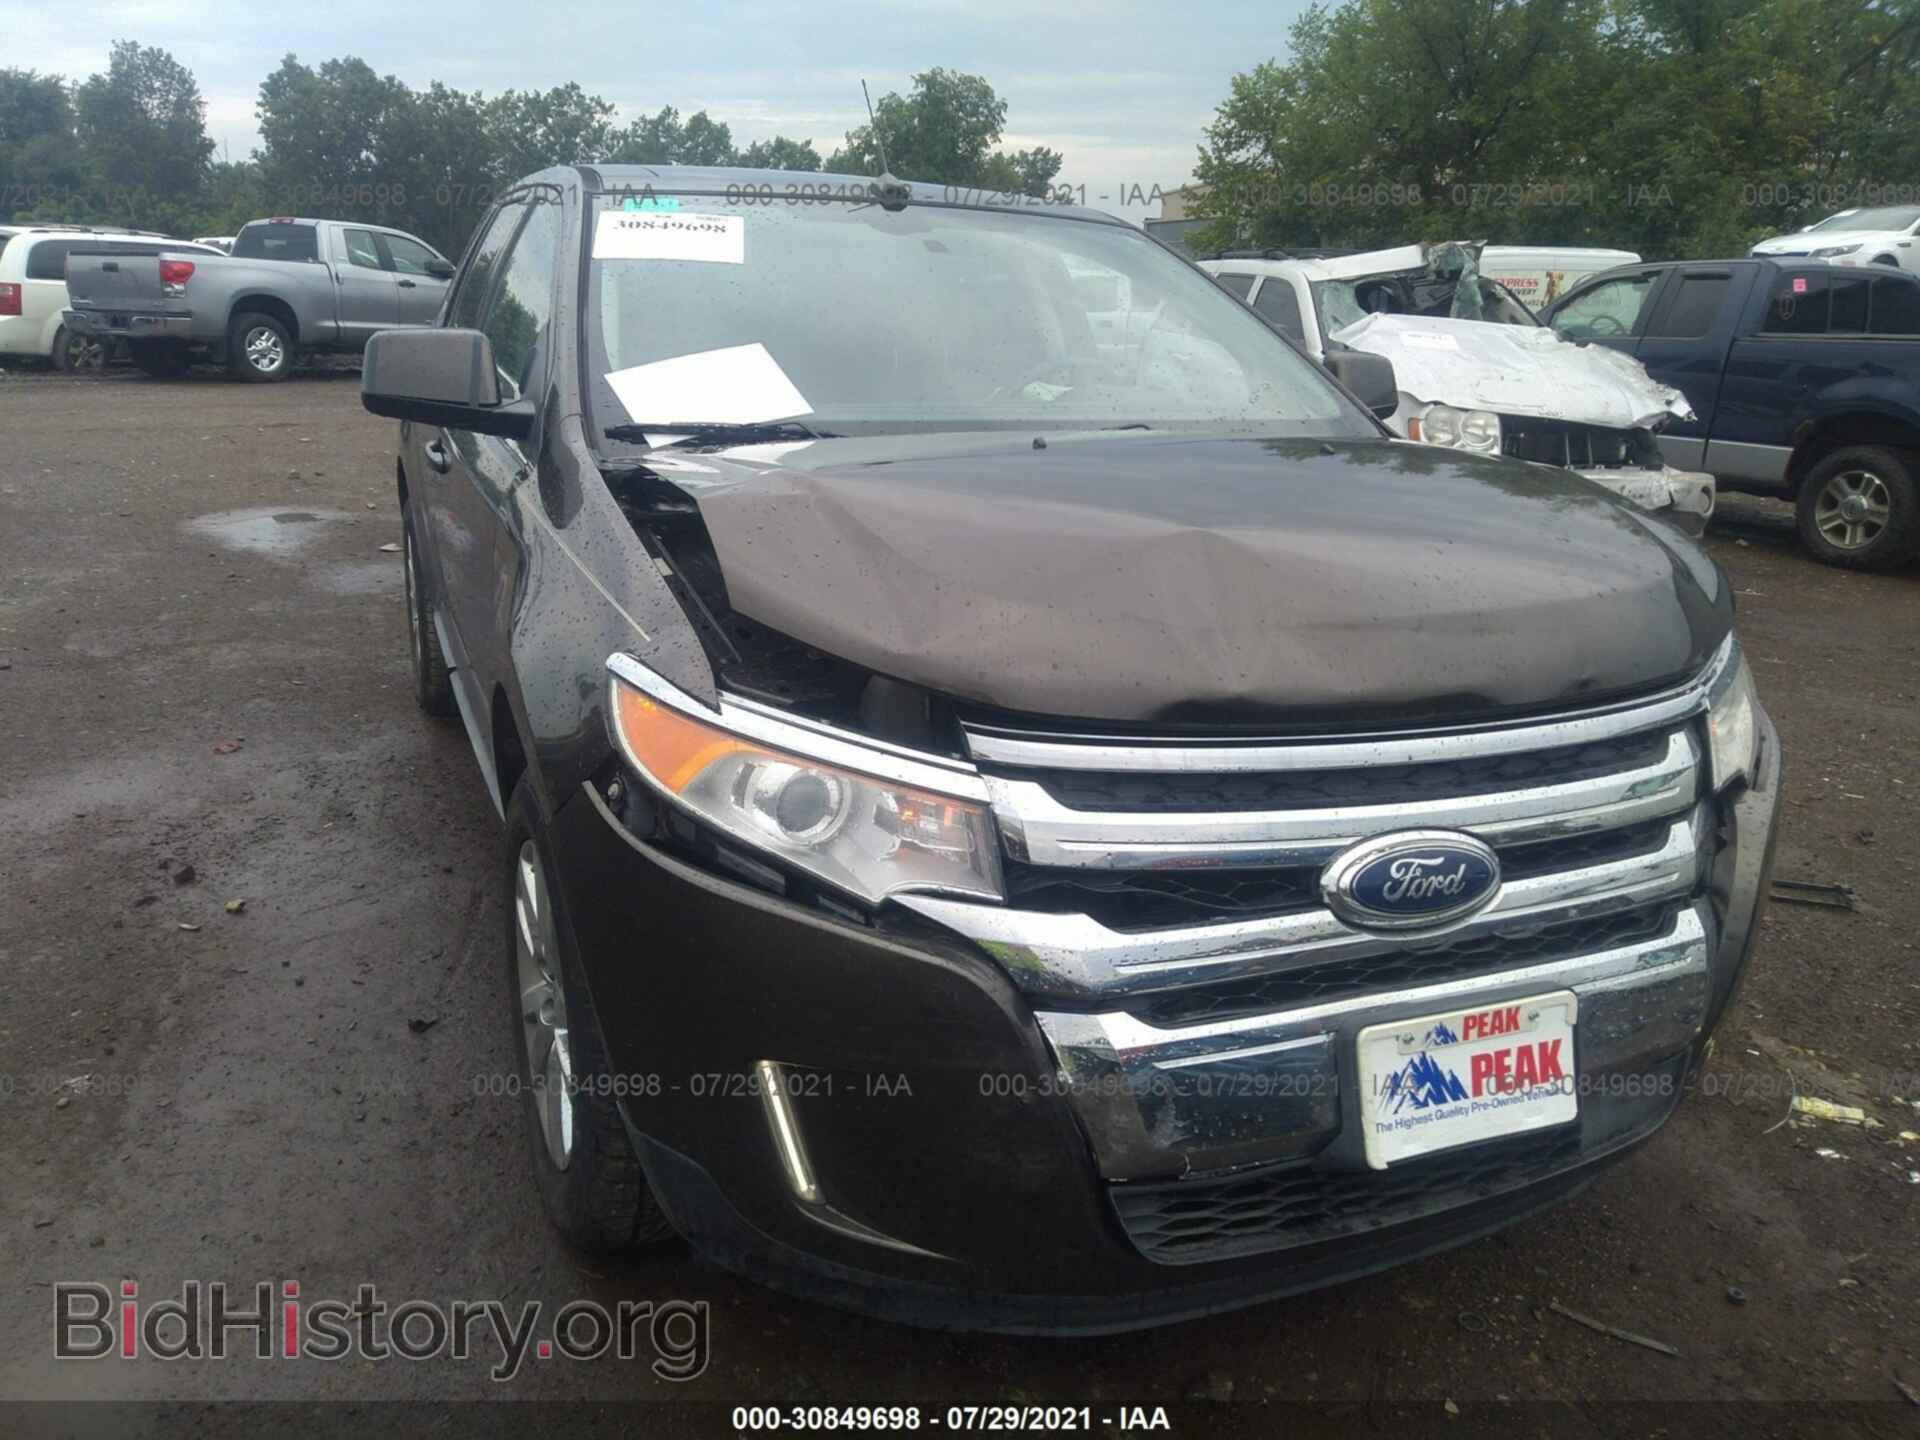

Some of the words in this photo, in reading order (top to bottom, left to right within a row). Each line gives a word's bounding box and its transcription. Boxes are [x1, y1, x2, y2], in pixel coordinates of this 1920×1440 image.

[1383, 856, 1467, 902] Ford
[1462, 1006, 1522, 1042] PEAK
[1470, 1038, 1563, 1099] PEAK
[1376, 1121, 1394, 1134] The
[1394, 1113, 1434, 1130] Highest
[1434, 1105, 1470, 1120] Quality
[1471, 1094, 1525, 1113] Pre-Owned
[1526, 1085, 1563, 1102] Vehi
